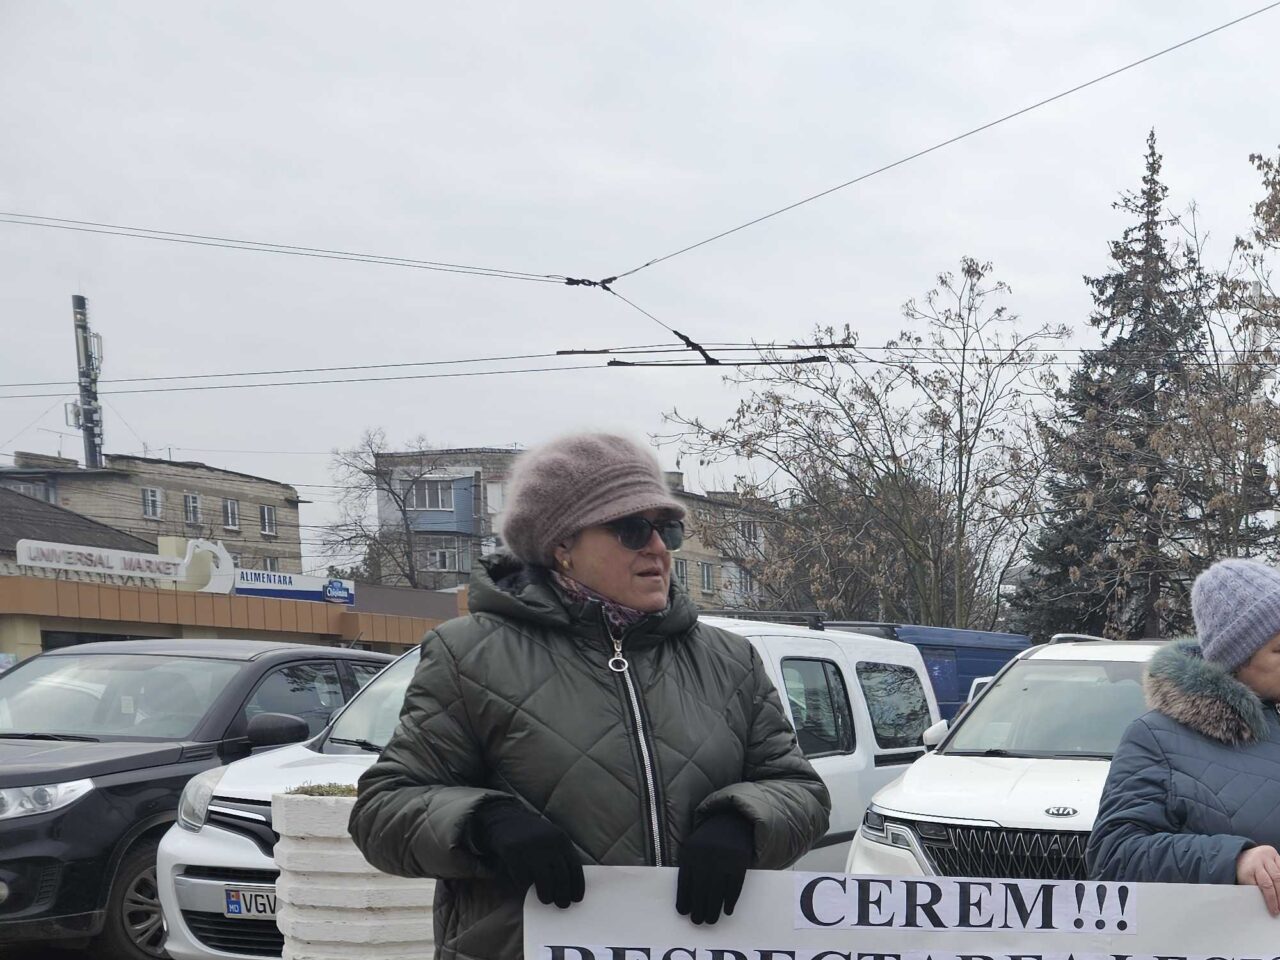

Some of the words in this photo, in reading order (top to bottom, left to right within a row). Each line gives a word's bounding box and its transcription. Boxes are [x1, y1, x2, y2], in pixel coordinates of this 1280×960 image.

[28, 545, 114, 570] UNIVERSAL
[121, 556, 181, 575] MARKET
[240, 571, 293, 586] ALIMENTARA
[229, 904, 239, 913] MD
